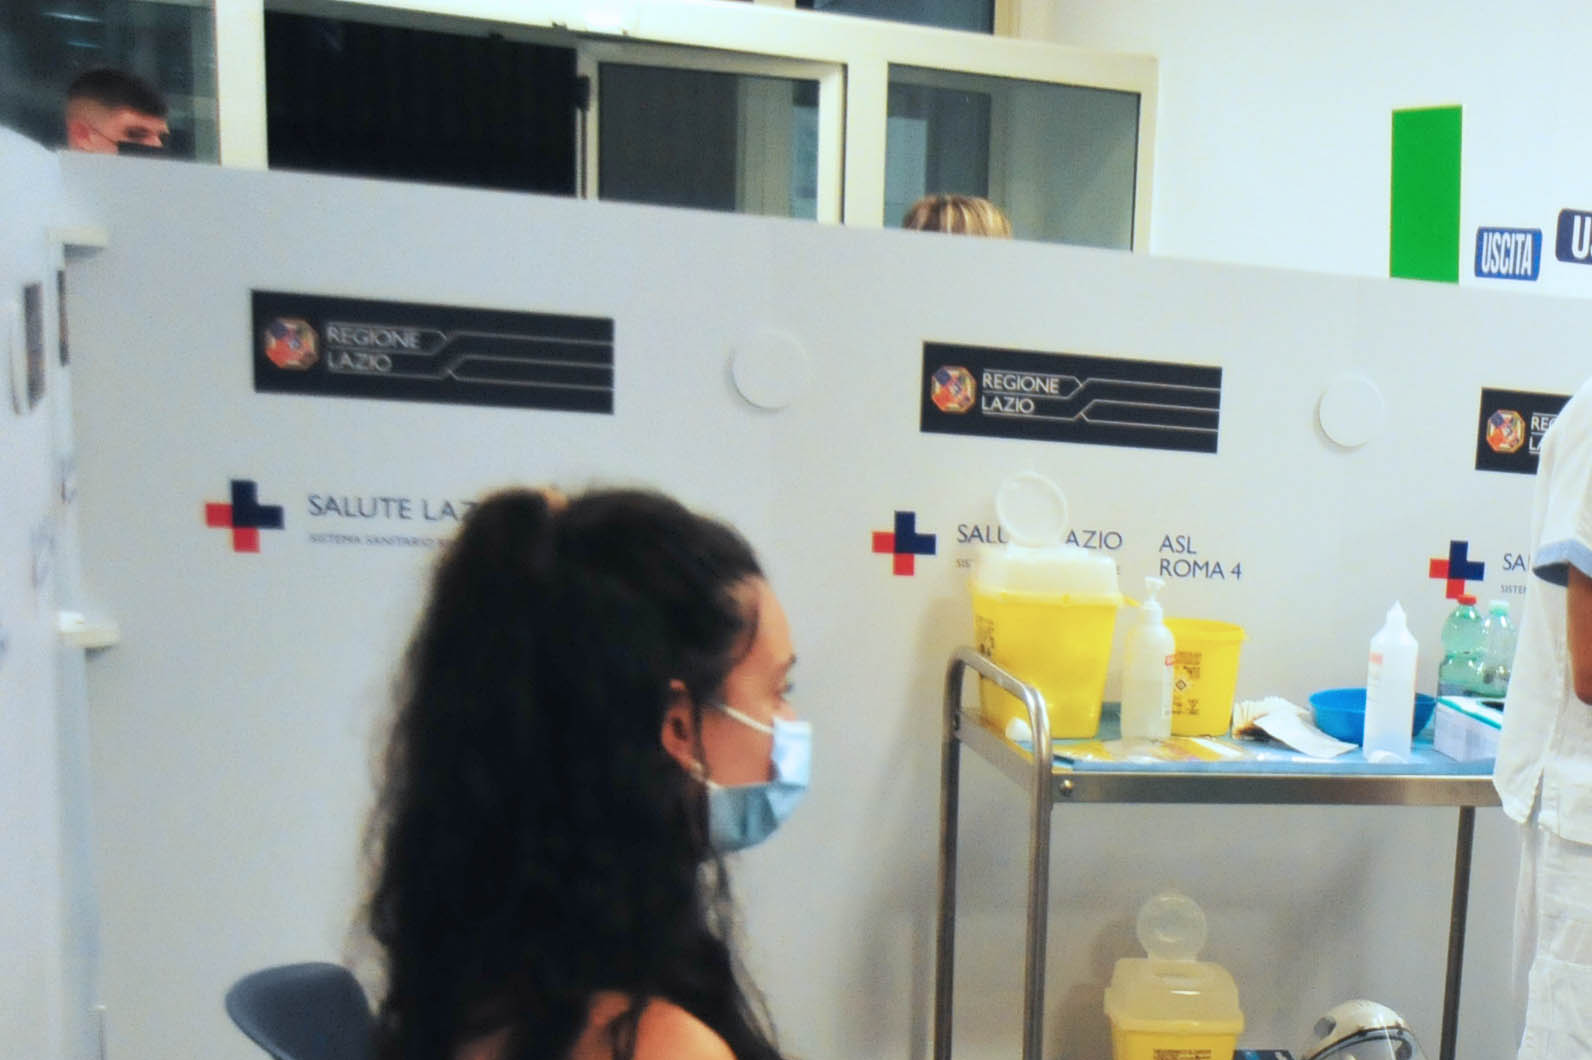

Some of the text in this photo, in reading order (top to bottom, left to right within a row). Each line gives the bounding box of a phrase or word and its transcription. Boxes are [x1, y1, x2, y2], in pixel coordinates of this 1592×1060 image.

[1481, 231, 1533, 276] USCITA
[326, 325, 419, 348] REGIONE
[326, 351, 392, 372] LAZIO
[982, 372, 1059, 394] REGIONE
[981, 395, 1035, 414] LAZIO
[307, 494, 413, 521] SALUTE
[1064, 529, 1123, 550] AZIO
[1159, 535, 1196, 554] ASL
[1159, 559, 1242, 581] ROMA 4
